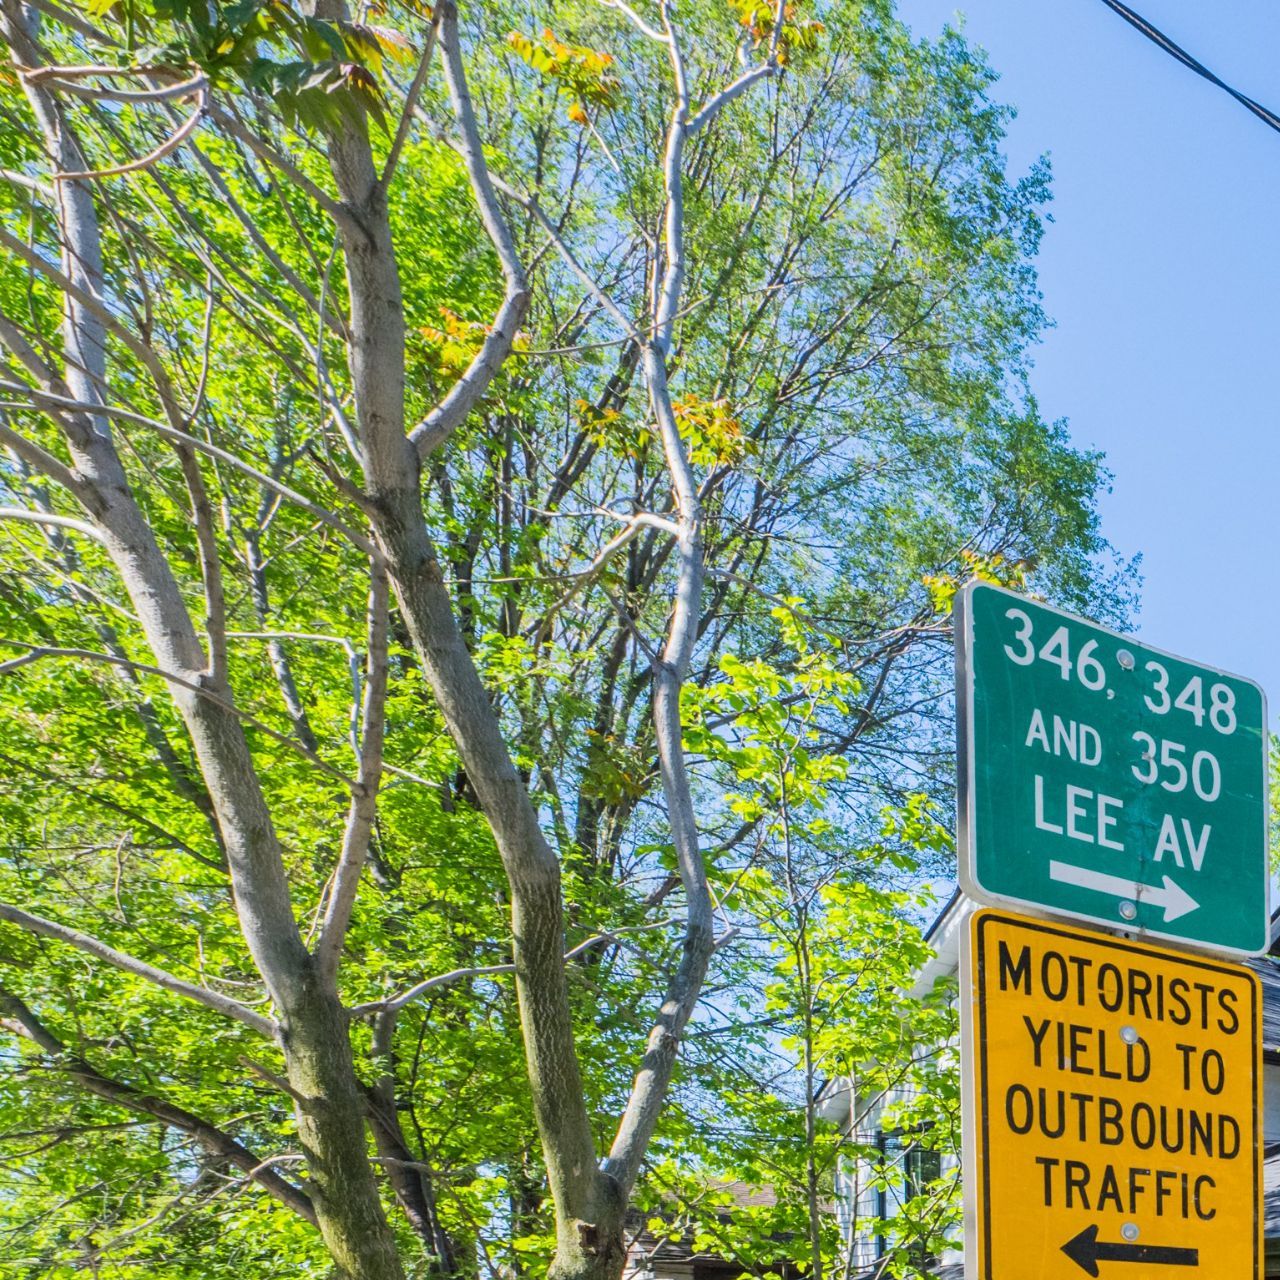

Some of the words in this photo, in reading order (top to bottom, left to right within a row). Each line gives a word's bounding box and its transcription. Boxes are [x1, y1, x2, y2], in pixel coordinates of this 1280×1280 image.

[1003, 608, 1116, 700] 346,
[1143, 661, 1237, 735] 348
[1025, 708, 1102, 767] AND
[1131, 731, 1221, 802] 350
[1034, 774, 1124, 851] LEE
[1153, 814, 1212, 872] AV
[998, 940, 1239, 1035] MOTORISTS
[1022, 1015, 1151, 1083] YIELD
[1175, 1043, 1225, 1096] TO
[1005, 1083, 1241, 1160] OUTBOUND
[1035, 1156, 1217, 1221] TRAFFIC
